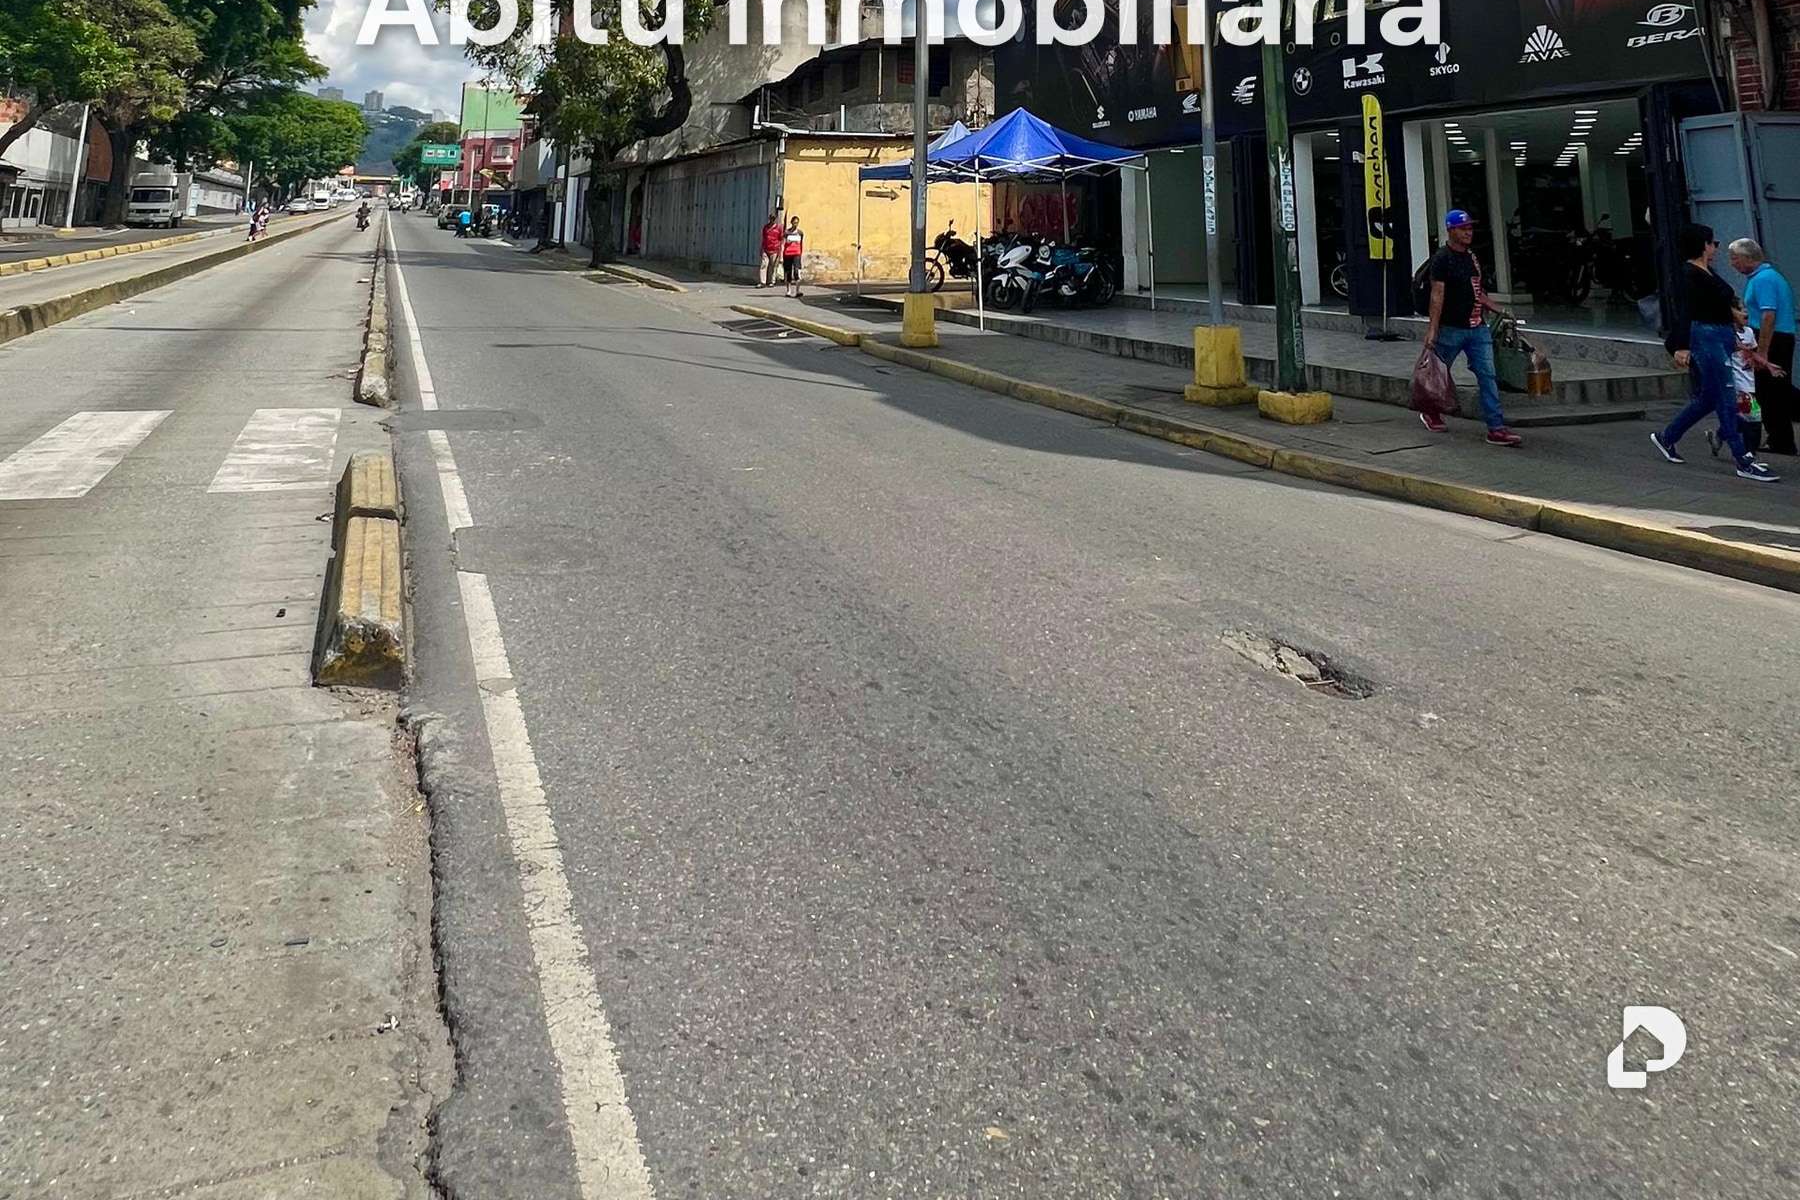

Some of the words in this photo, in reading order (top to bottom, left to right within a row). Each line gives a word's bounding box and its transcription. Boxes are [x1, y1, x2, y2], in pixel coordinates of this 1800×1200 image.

[1626, 27, 1706, 48] BERA
[1527, 50, 1563, 64] AVA
[1429, 63, 1460, 77] SKYGO
[1343, 74, 1386, 89] Kawasaki
[1134, 106, 1158, 121] YAMAHA
